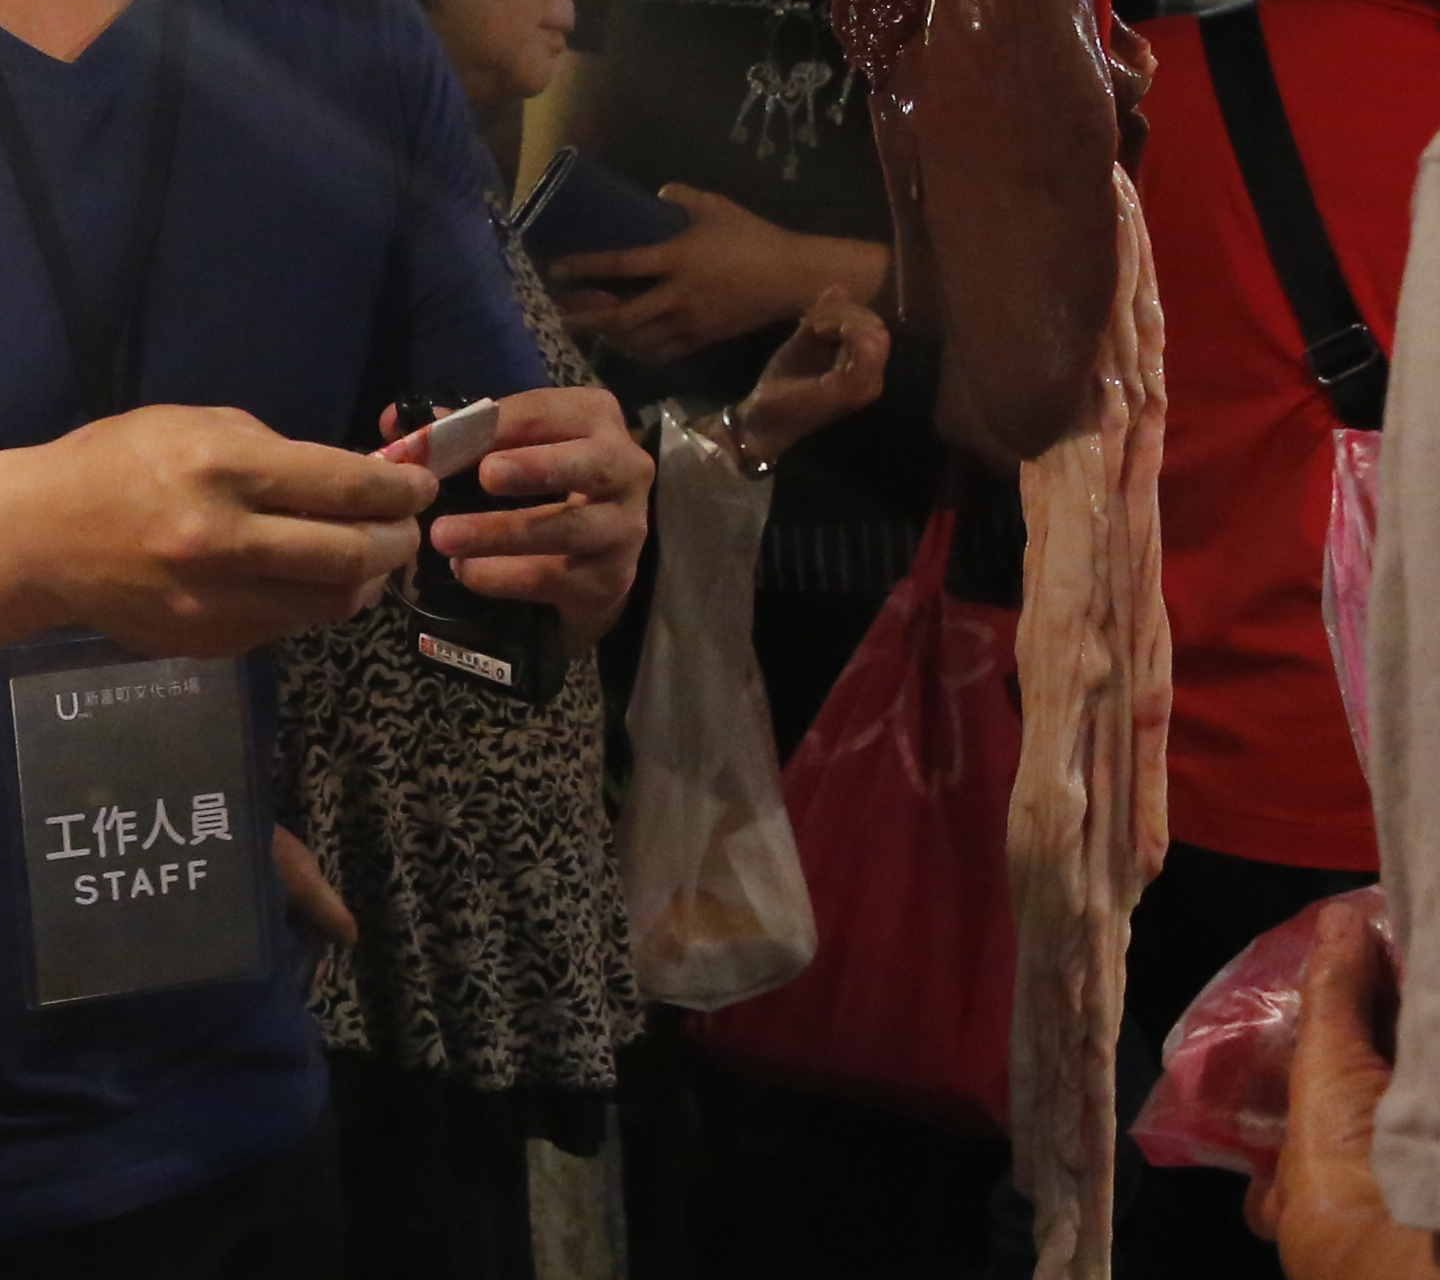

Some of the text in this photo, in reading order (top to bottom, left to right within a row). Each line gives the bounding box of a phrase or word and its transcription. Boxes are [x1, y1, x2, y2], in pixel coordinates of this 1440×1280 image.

[44, 791, 233, 861] 工作人員
[74, 859, 208, 906] STAFF
